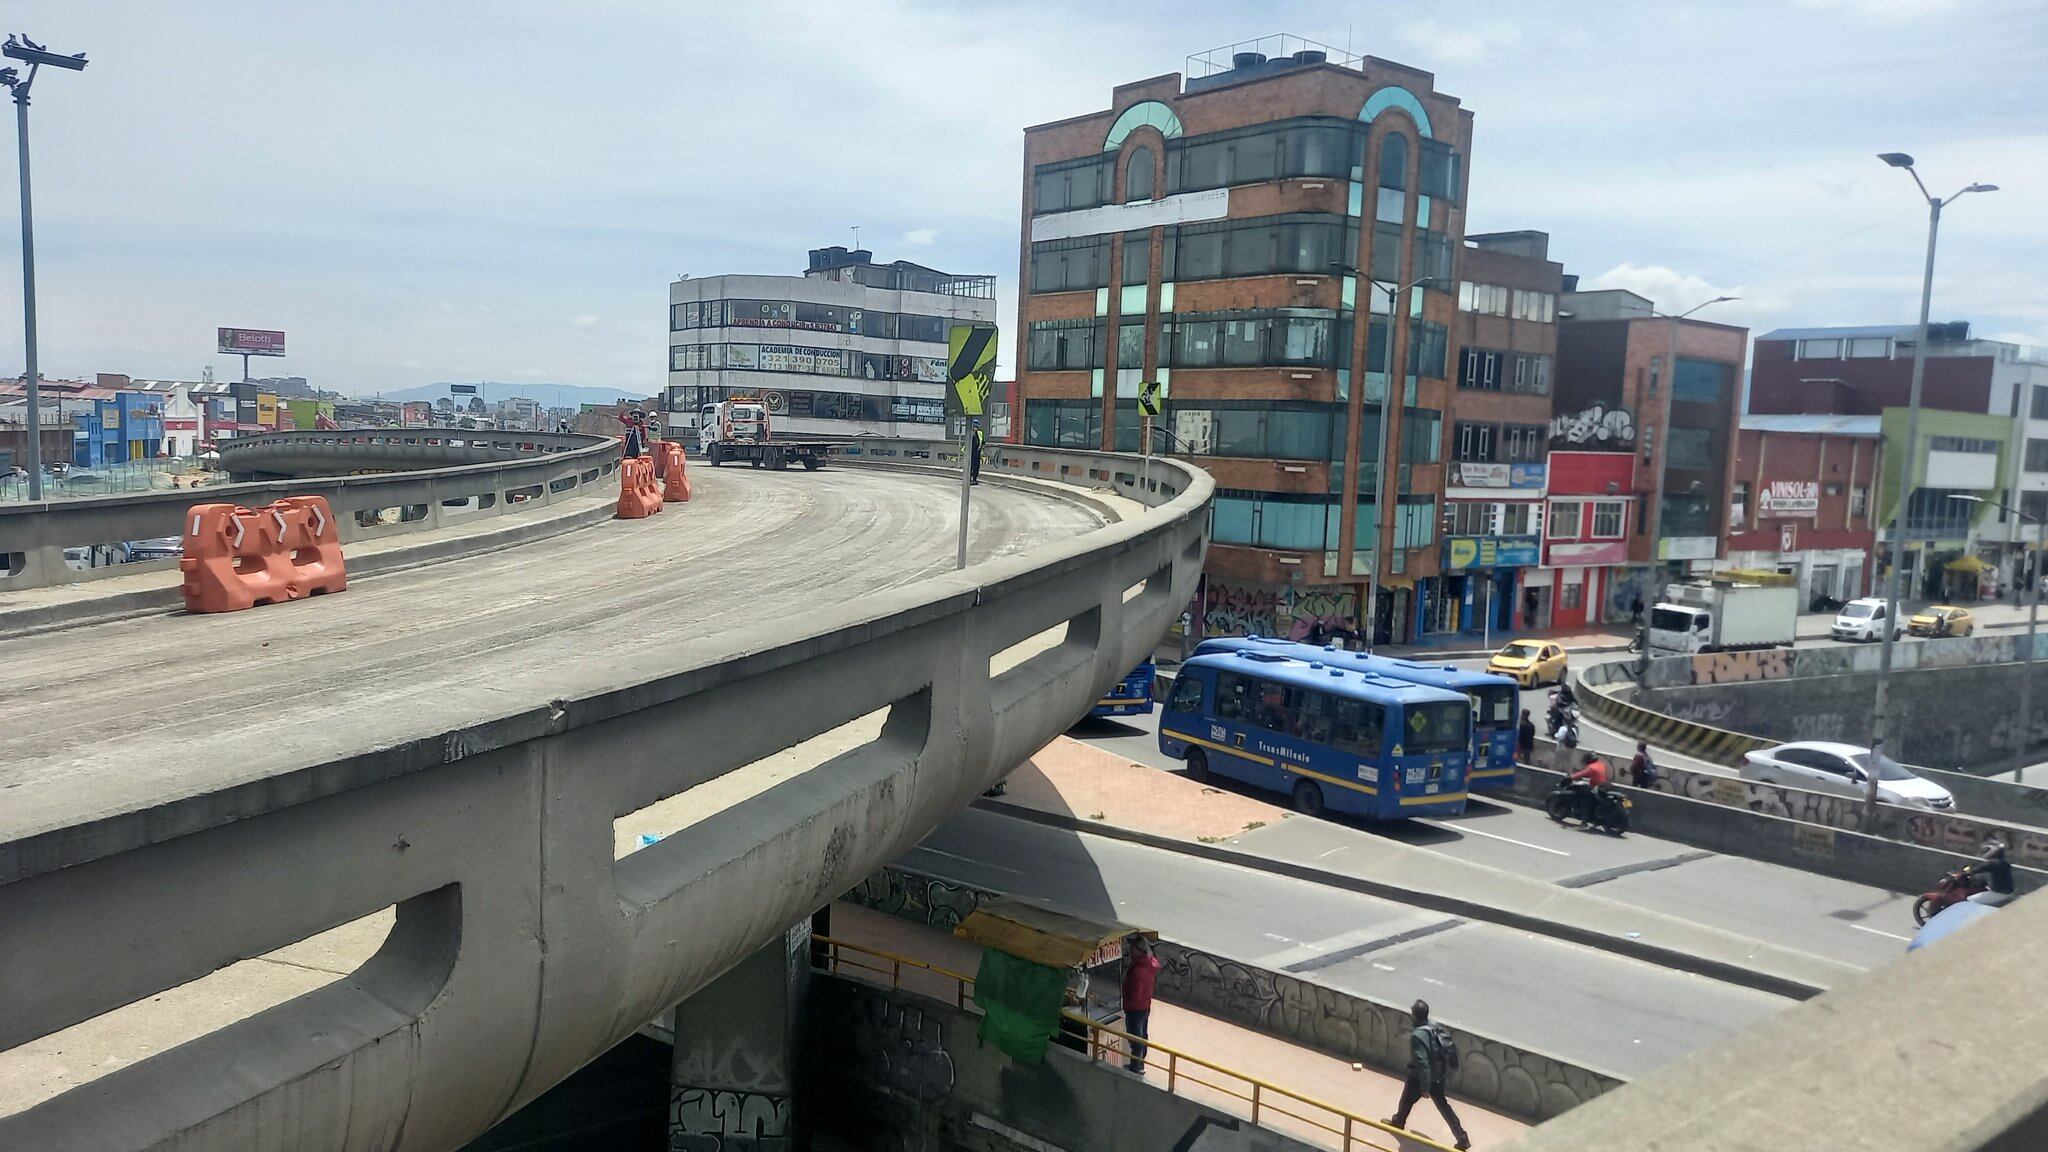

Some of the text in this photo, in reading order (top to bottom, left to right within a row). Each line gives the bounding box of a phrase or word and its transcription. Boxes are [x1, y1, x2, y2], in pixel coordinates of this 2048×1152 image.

[761, 346, 793, 355] ACADEMIA
[795, 347, 803, 355] DE
[792, 356, 812, 364] 390
[816, 358, 840, 367] 0705
[1258, 740, 1310, 764] TransMilenio
